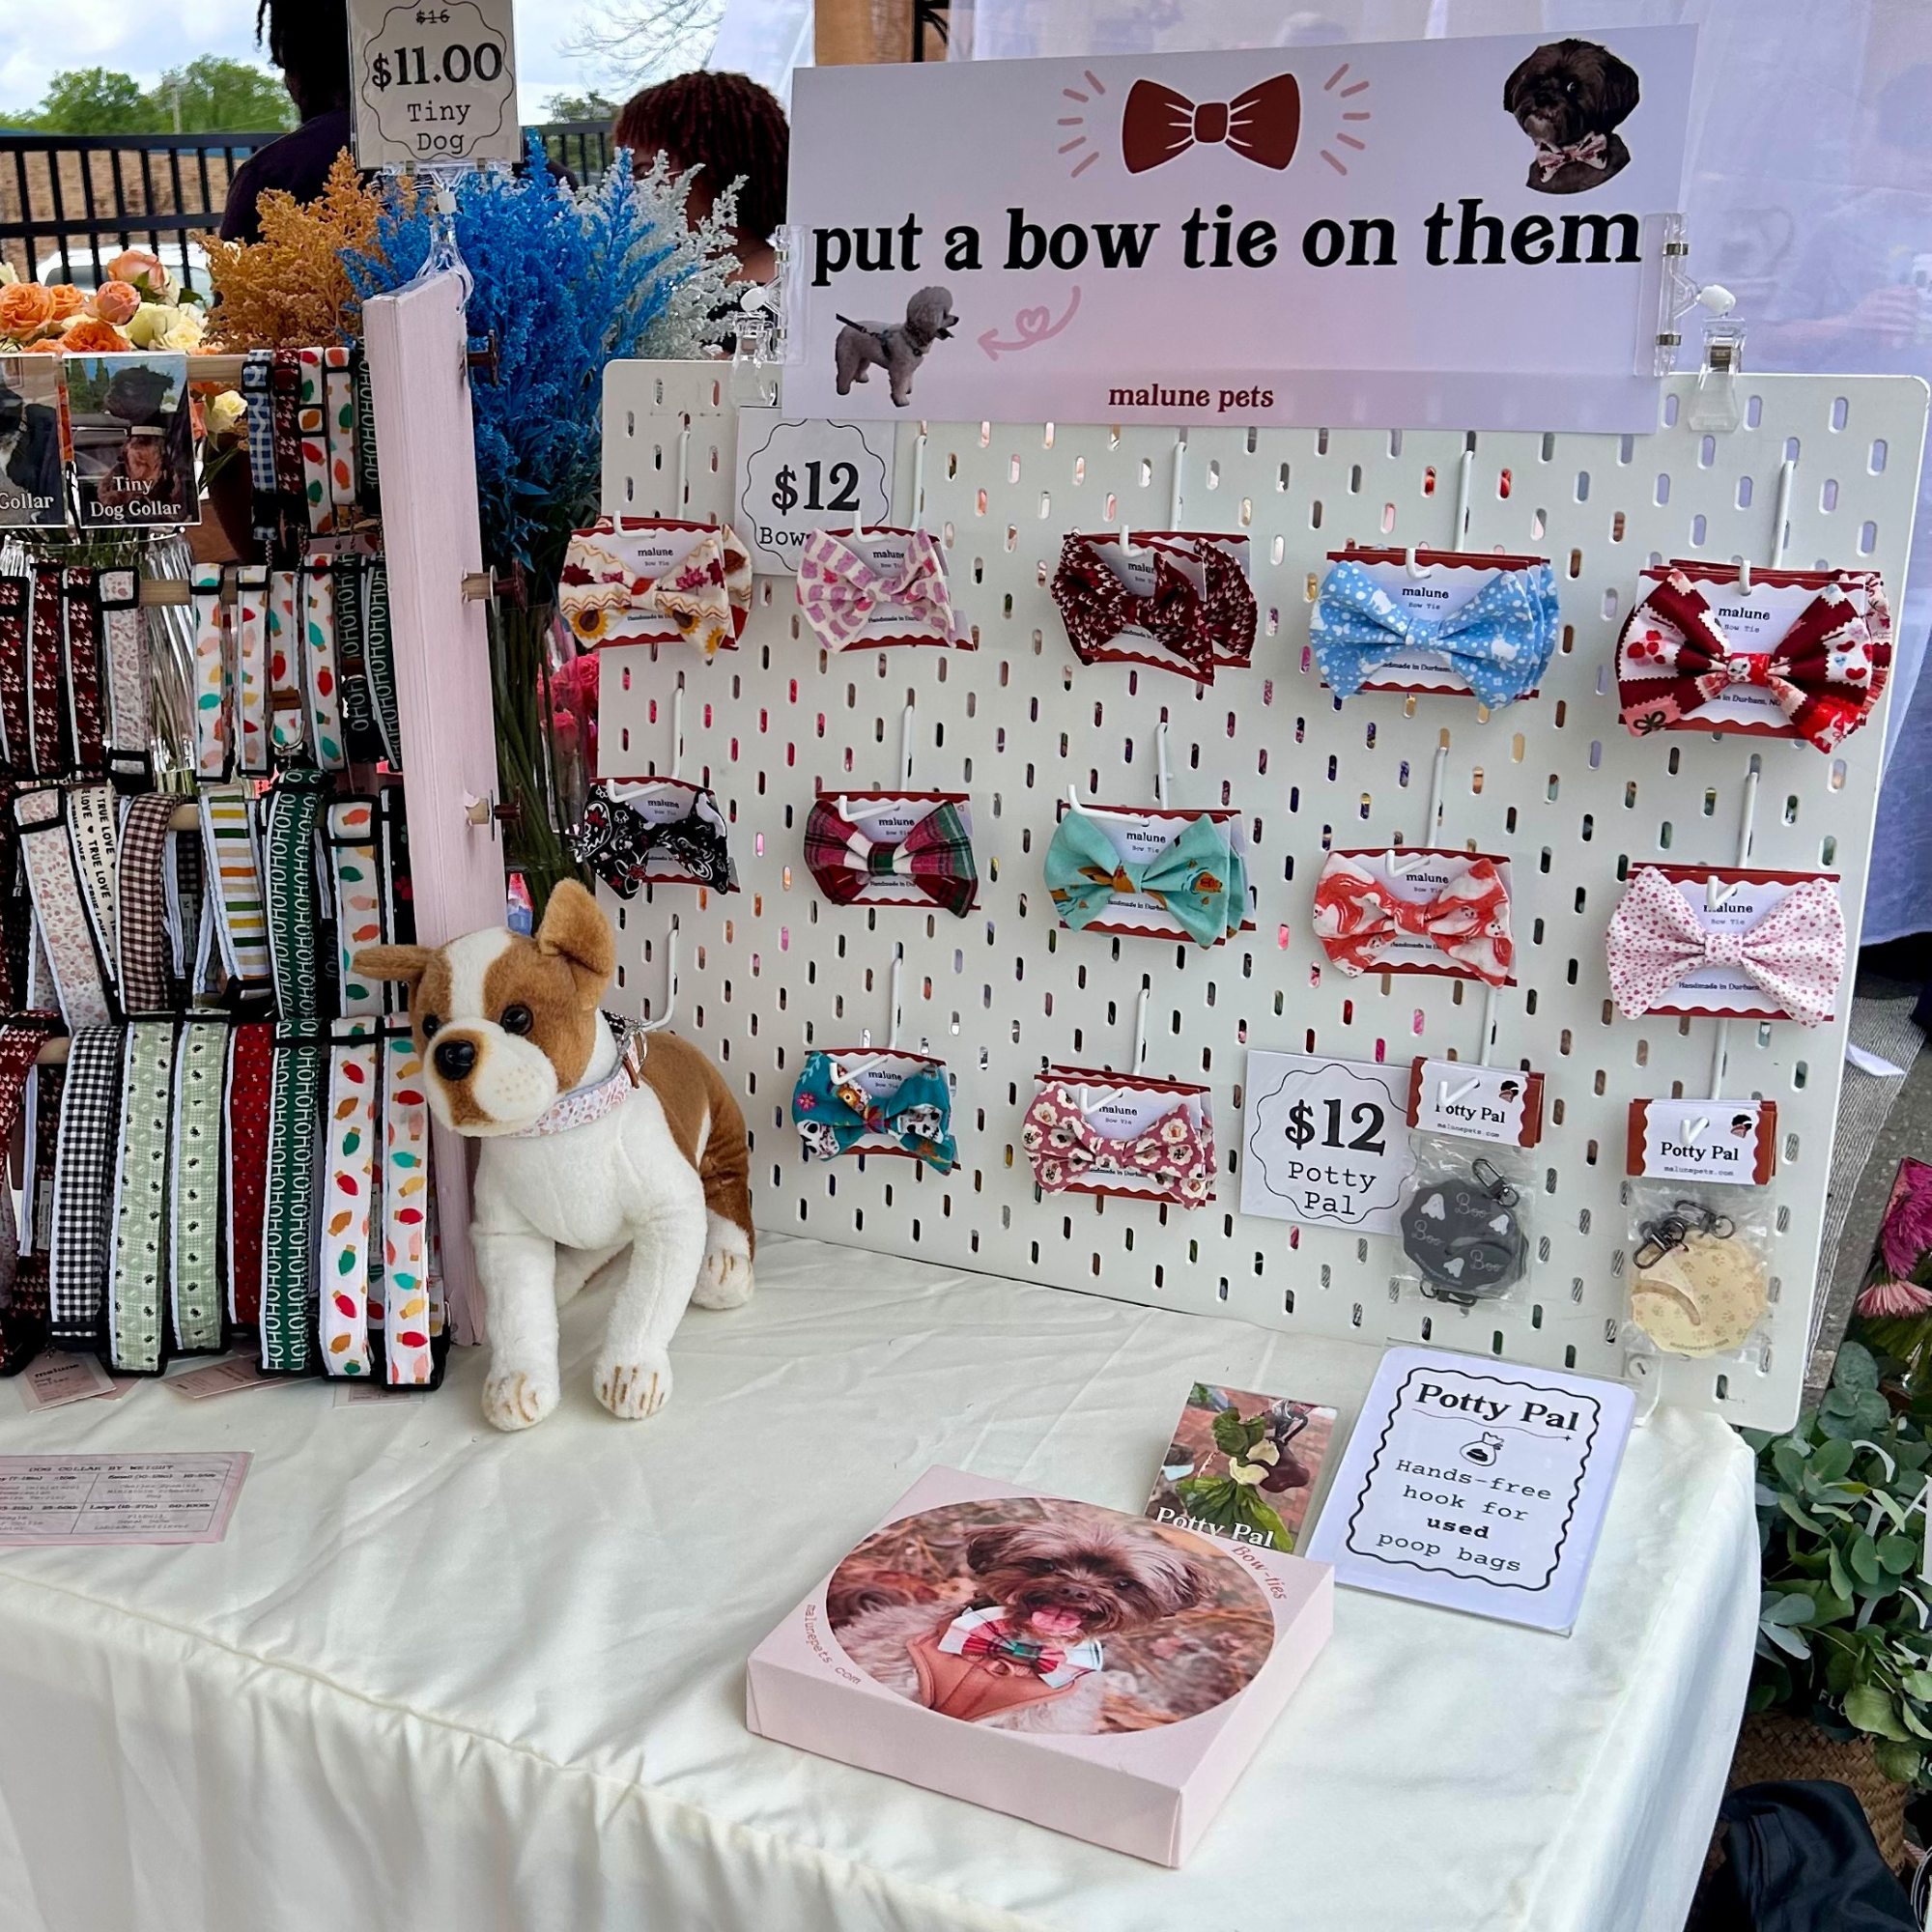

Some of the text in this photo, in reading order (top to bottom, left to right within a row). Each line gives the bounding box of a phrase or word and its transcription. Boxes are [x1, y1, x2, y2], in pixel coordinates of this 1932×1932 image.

[415, 9, 451, 25] $16
[371, 42, 503, 93] $11.00
[407, 99, 471, 126] Tiny
[416, 132, 466, 155] Dog
[810, 198, 1642, 287] put a bow tie on them
[1108, 383, 1274, 413] malune pets
[112, 475, 154, 496] Tiny
[771, 460, 861, 517] $12
[0, 493, 54, 510] Collar
[90, 500, 182, 520] Dog Collar
[638, 547, 674, 557] malune
[1402, 586, 1450, 600] malune
[1718, 607, 1771, 621] malune
[80, 796, 93, 819] LOVE
[97, 798, 116, 856] TRUE LOVE
[878, 817, 916, 827] malune
[1126, 832, 1167, 844] malune
[88, 839, 111, 899] TRUE LOVE
[1406, 872, 1450, 885] malune
[867, 1070, 903, 1082] malune
[1284, 1098, 1386, 1157] $12
[1481, 1107, 1506, 1123] Pal
[1660, 1141, 1740, 1163] Potty Pal
[1288, 1160, 1378, 1194] Potty
[1304, 1190, 1356, 1216] Pal
[1414, 1382, 1580, 1433] Potty Pal
[1395, 1458, 1552, 1501] Hands-free
[1403, 1484, 1529, 1522] hook for
[1155, 1505, 1275, 1549] Potty Pal
[1426, 1515, 1491, 1540] used
[1376, 1532, 1521, 1574] poop bags
[1231, 1545, 1288, 1601] Bow-ties
[804, 1603, 863, 1686] malunepets.com
